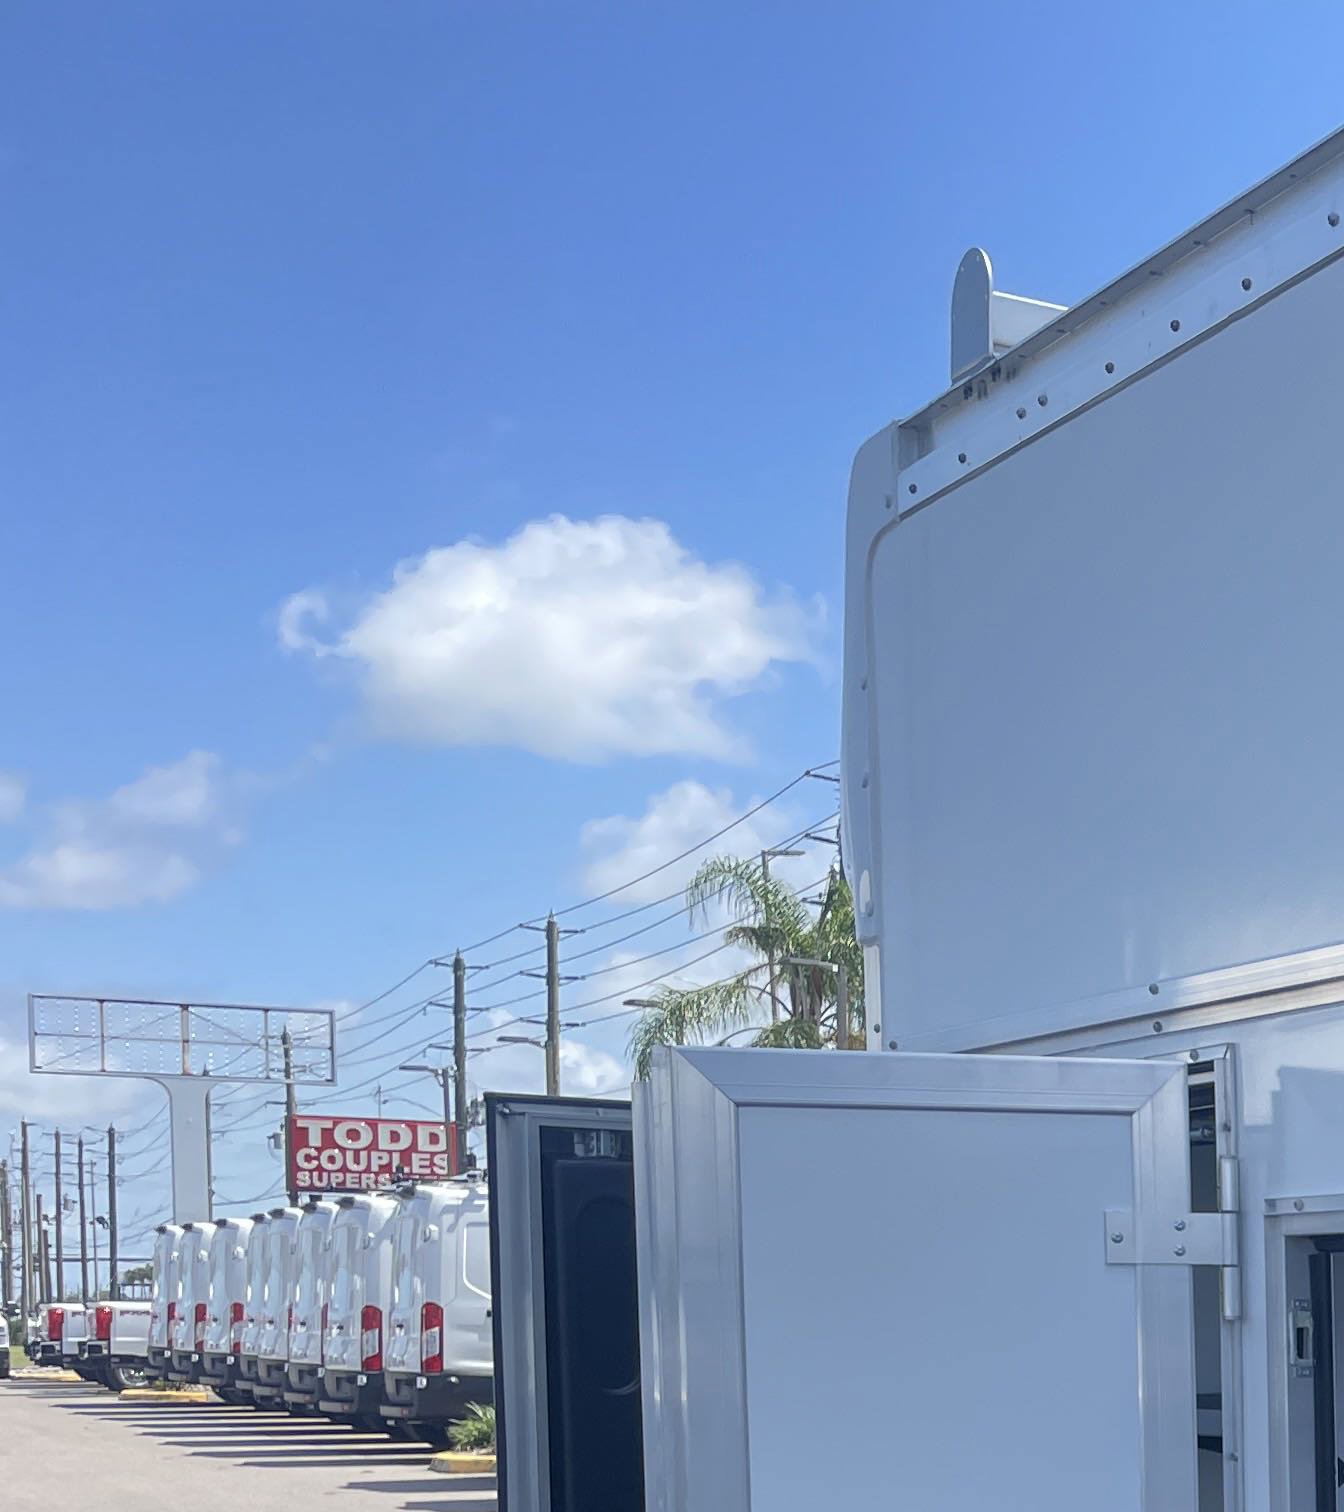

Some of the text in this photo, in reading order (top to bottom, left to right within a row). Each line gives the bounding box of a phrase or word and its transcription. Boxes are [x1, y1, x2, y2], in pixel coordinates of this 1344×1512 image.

[296, 1120, 446, 1152] TODD
[296, 1148, 448, 1175] COUPLES
[296, 1171, 448, 1188] SUPERS
